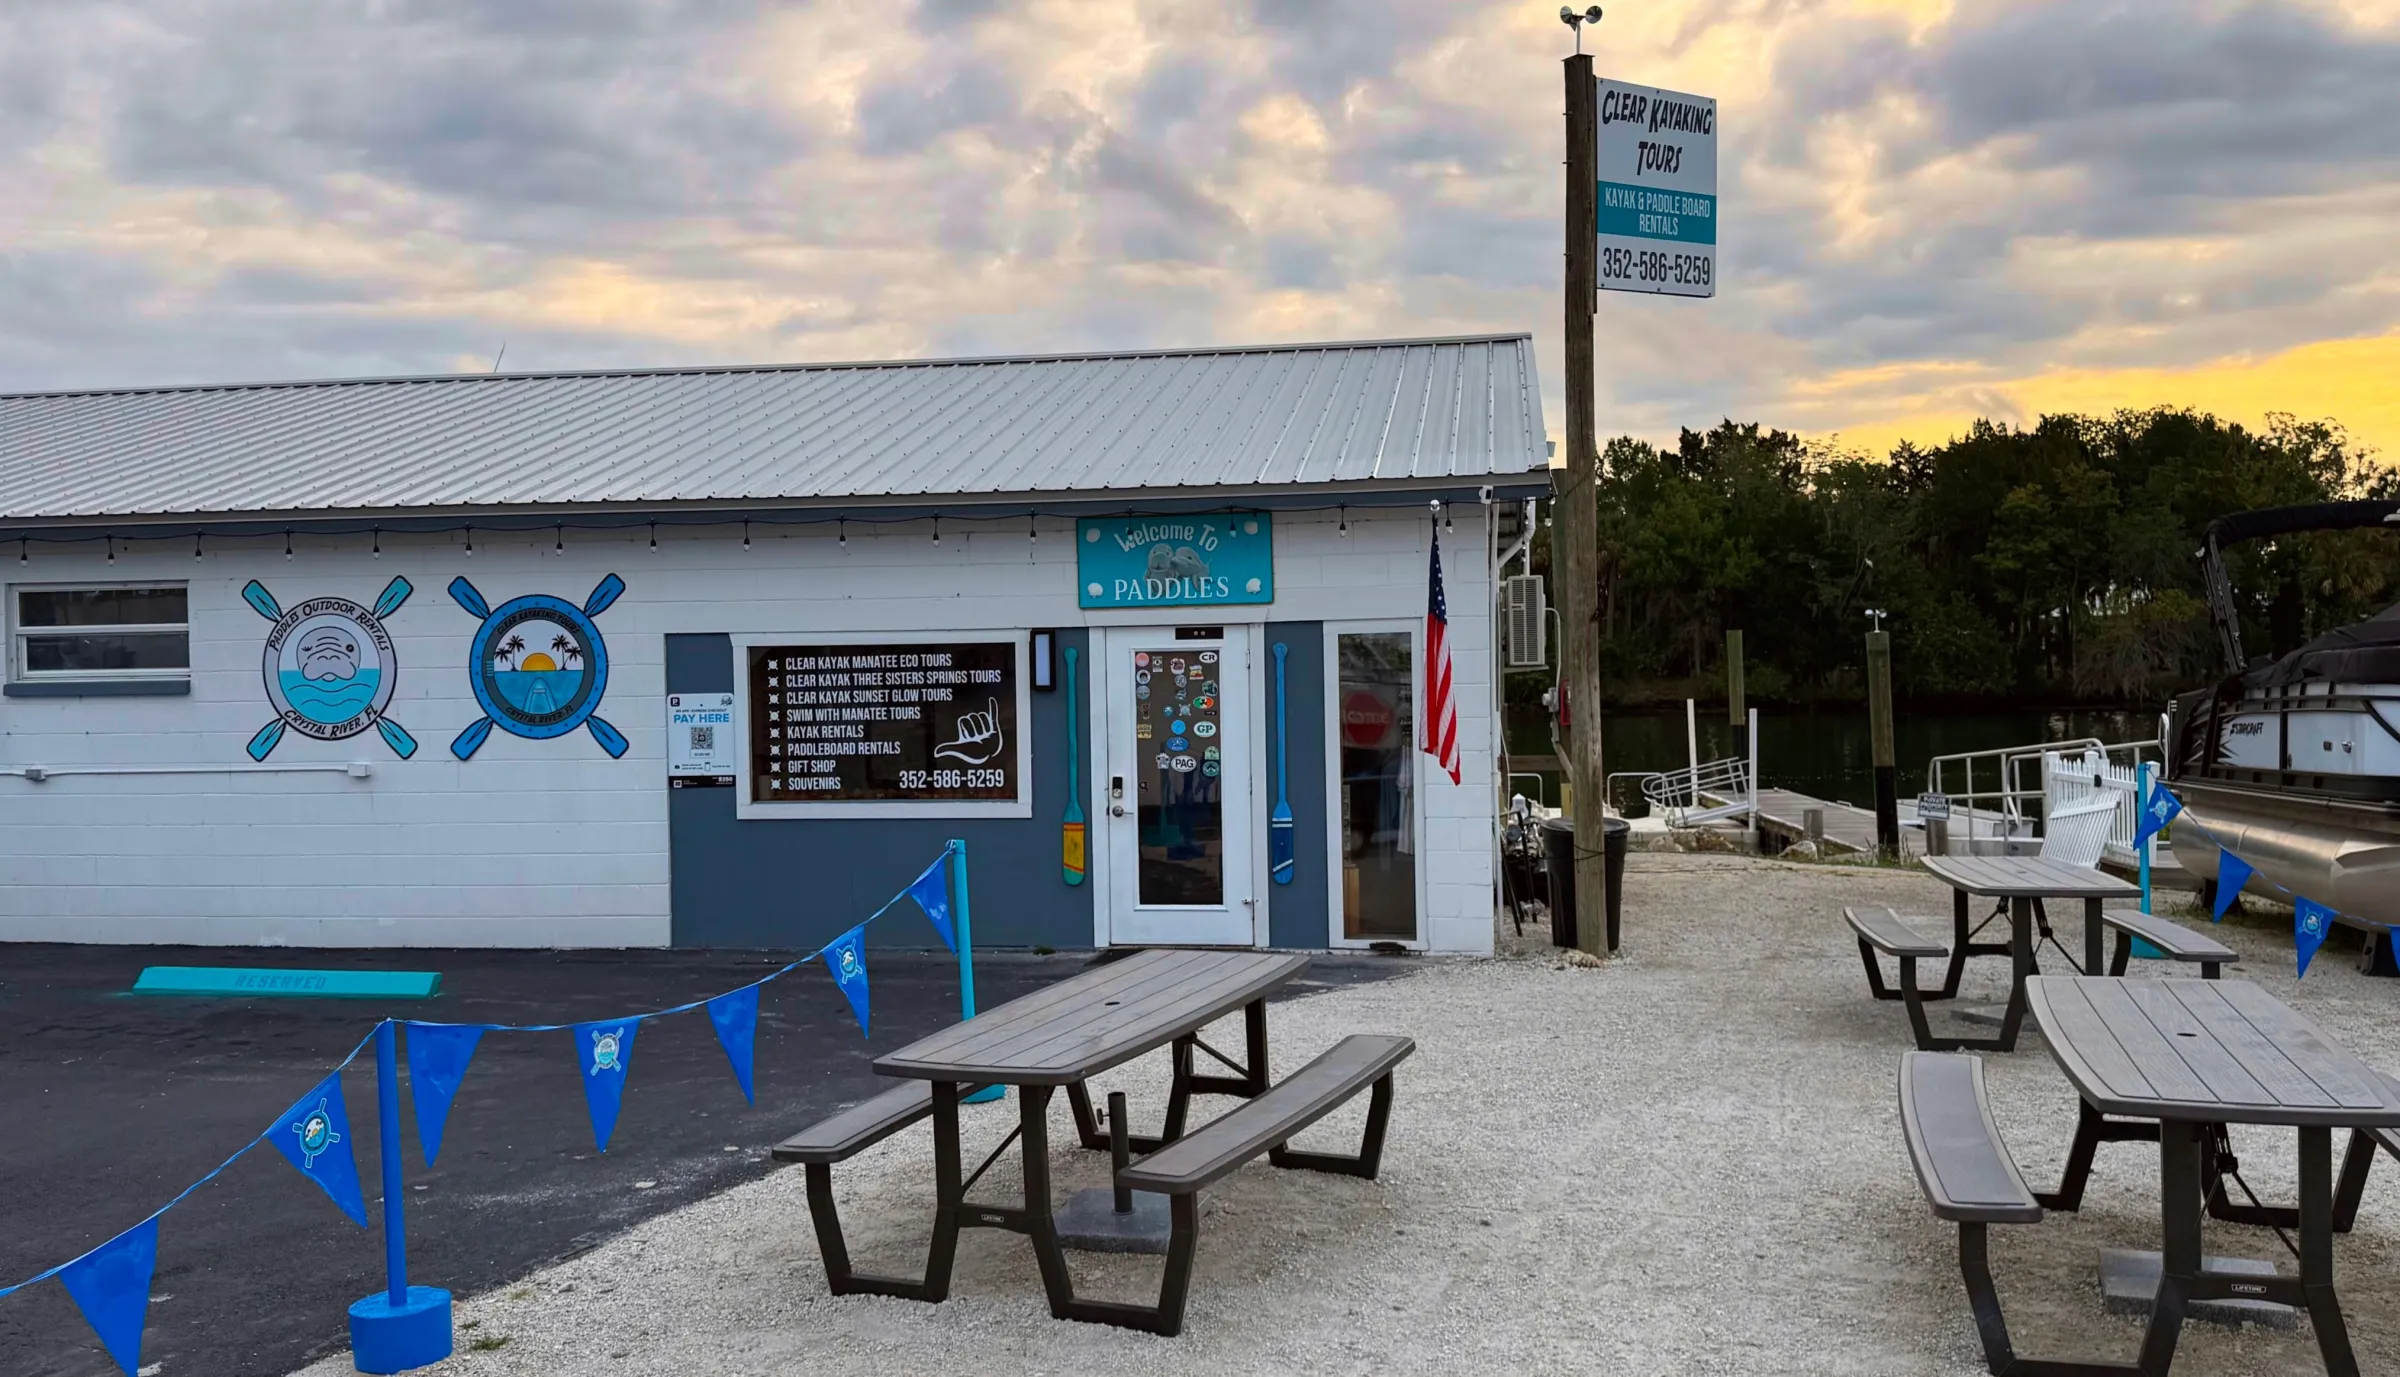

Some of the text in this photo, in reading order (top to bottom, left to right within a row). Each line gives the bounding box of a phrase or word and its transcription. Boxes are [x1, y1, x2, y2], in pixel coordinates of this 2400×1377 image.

[1602, 90, 1712, 135] CLEAR KAYAKING
[1637, 141, 1682, 176] TOURS
[1605, 187, 1710, 218] KAYAK & PADDLE BOARD
[1639, 213, 1679, 236] RENTALS
[1603, 247, 1710, 285] 352-586-5259
[1114, 523, 1218, 553] Welcome To
[1114, 576, 1229, 601] PADDLES
[269, 601, 390, 652] PADDLES OUTDOOR RENTALS
[786, 653, 952, 670] CLEAR KAYAK MANATEE ECO TOURS
[1201, 653, 1216, 662] CR
[786, 669, 1001, 688] CLEAR KAYAK THREE SISTERS SPRINGS TOURS
[786, 688, 952, 705] CLEAR KAYAK SUNSET GLOW TOURS
[284, 709, 326, 735] CRYSTAL
[365, 704, 379, 722] FL
[674, 713, 729, 723] PAY HERE
[787, 706, 921, 722] SWIM WITH MANATEE TOURS
[787, 724, 864, 739] KAYAK RENTALS
[1197, 725, 1214, 734] GP
[788, 741, 901, 756] PADDLEBOARD RENTALS
[788, 759, 836, 773] GIFT SHOP
[1175, 759, 1194, 768] PAG
[788, 777, 841, 790] SOUVENIRS
[899, 769, 1004, 789] 352-586-5259
[235, 974, 327, 990] RESERVED
